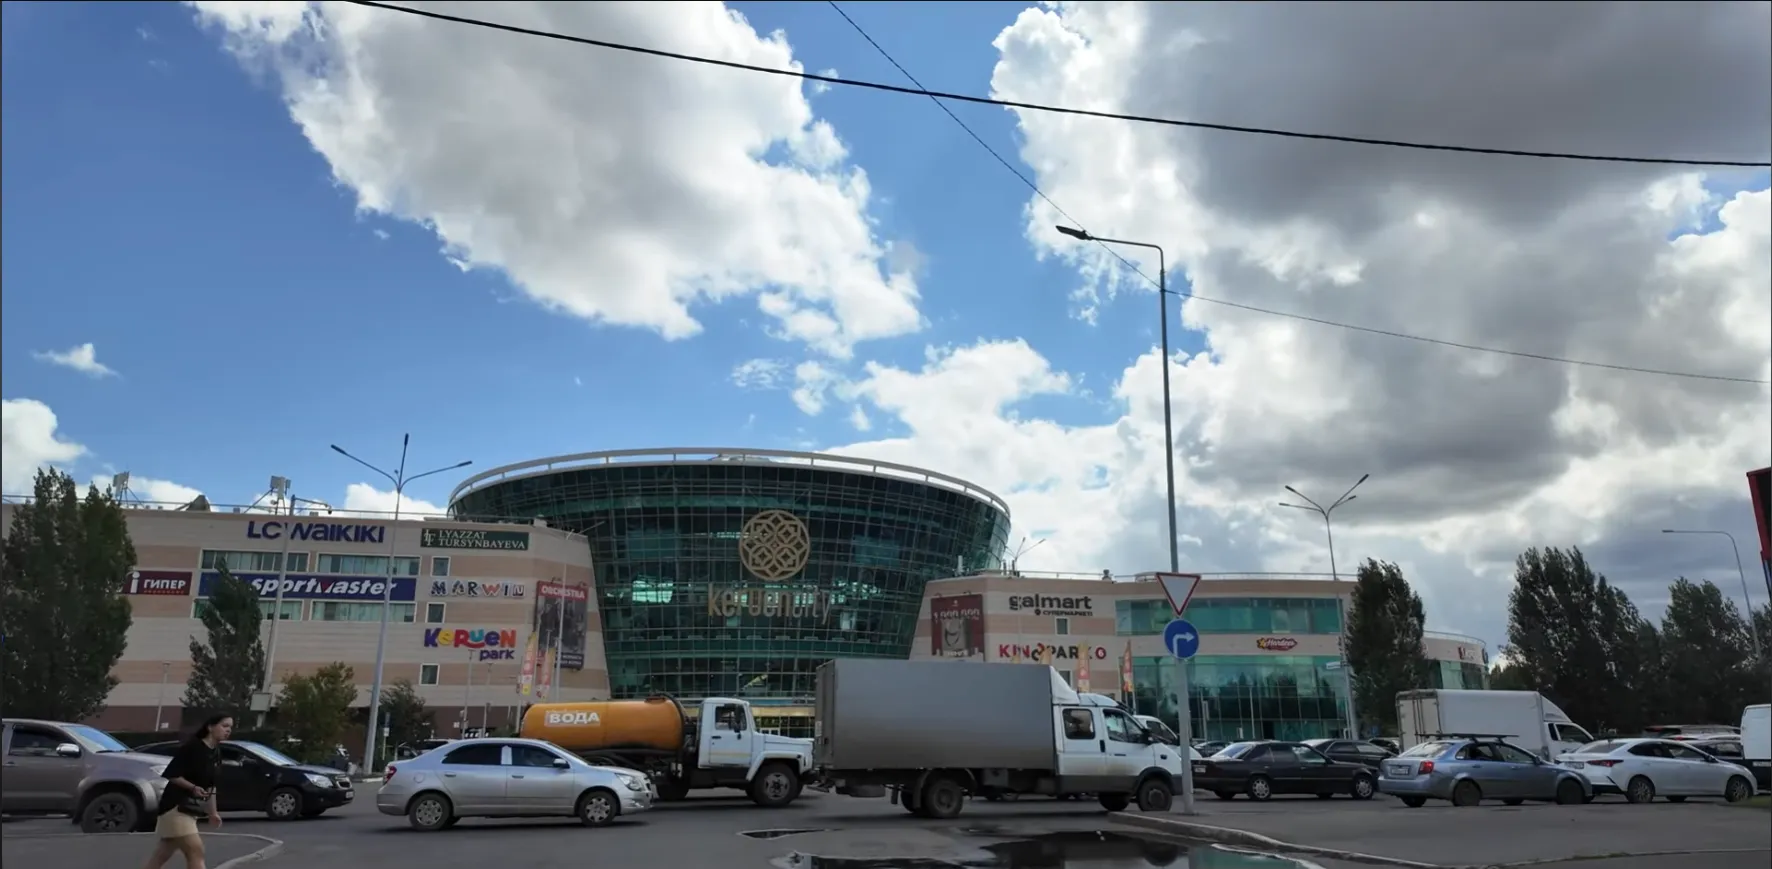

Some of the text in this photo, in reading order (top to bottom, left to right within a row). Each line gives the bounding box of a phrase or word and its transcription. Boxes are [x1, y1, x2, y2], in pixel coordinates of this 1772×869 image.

[439, 531, 487, 540] LYAZZAT
[439, 539, 526, 549] TURSYNBAYEVA
[143, 579, 187, 590] ГИПЕР
[430, 580, 525, 597] MARWIN
[1008, 593, 1092, 611] galmart
[479, 650, 515, 661] park
[549, 712, 600, 724] ВОДА
